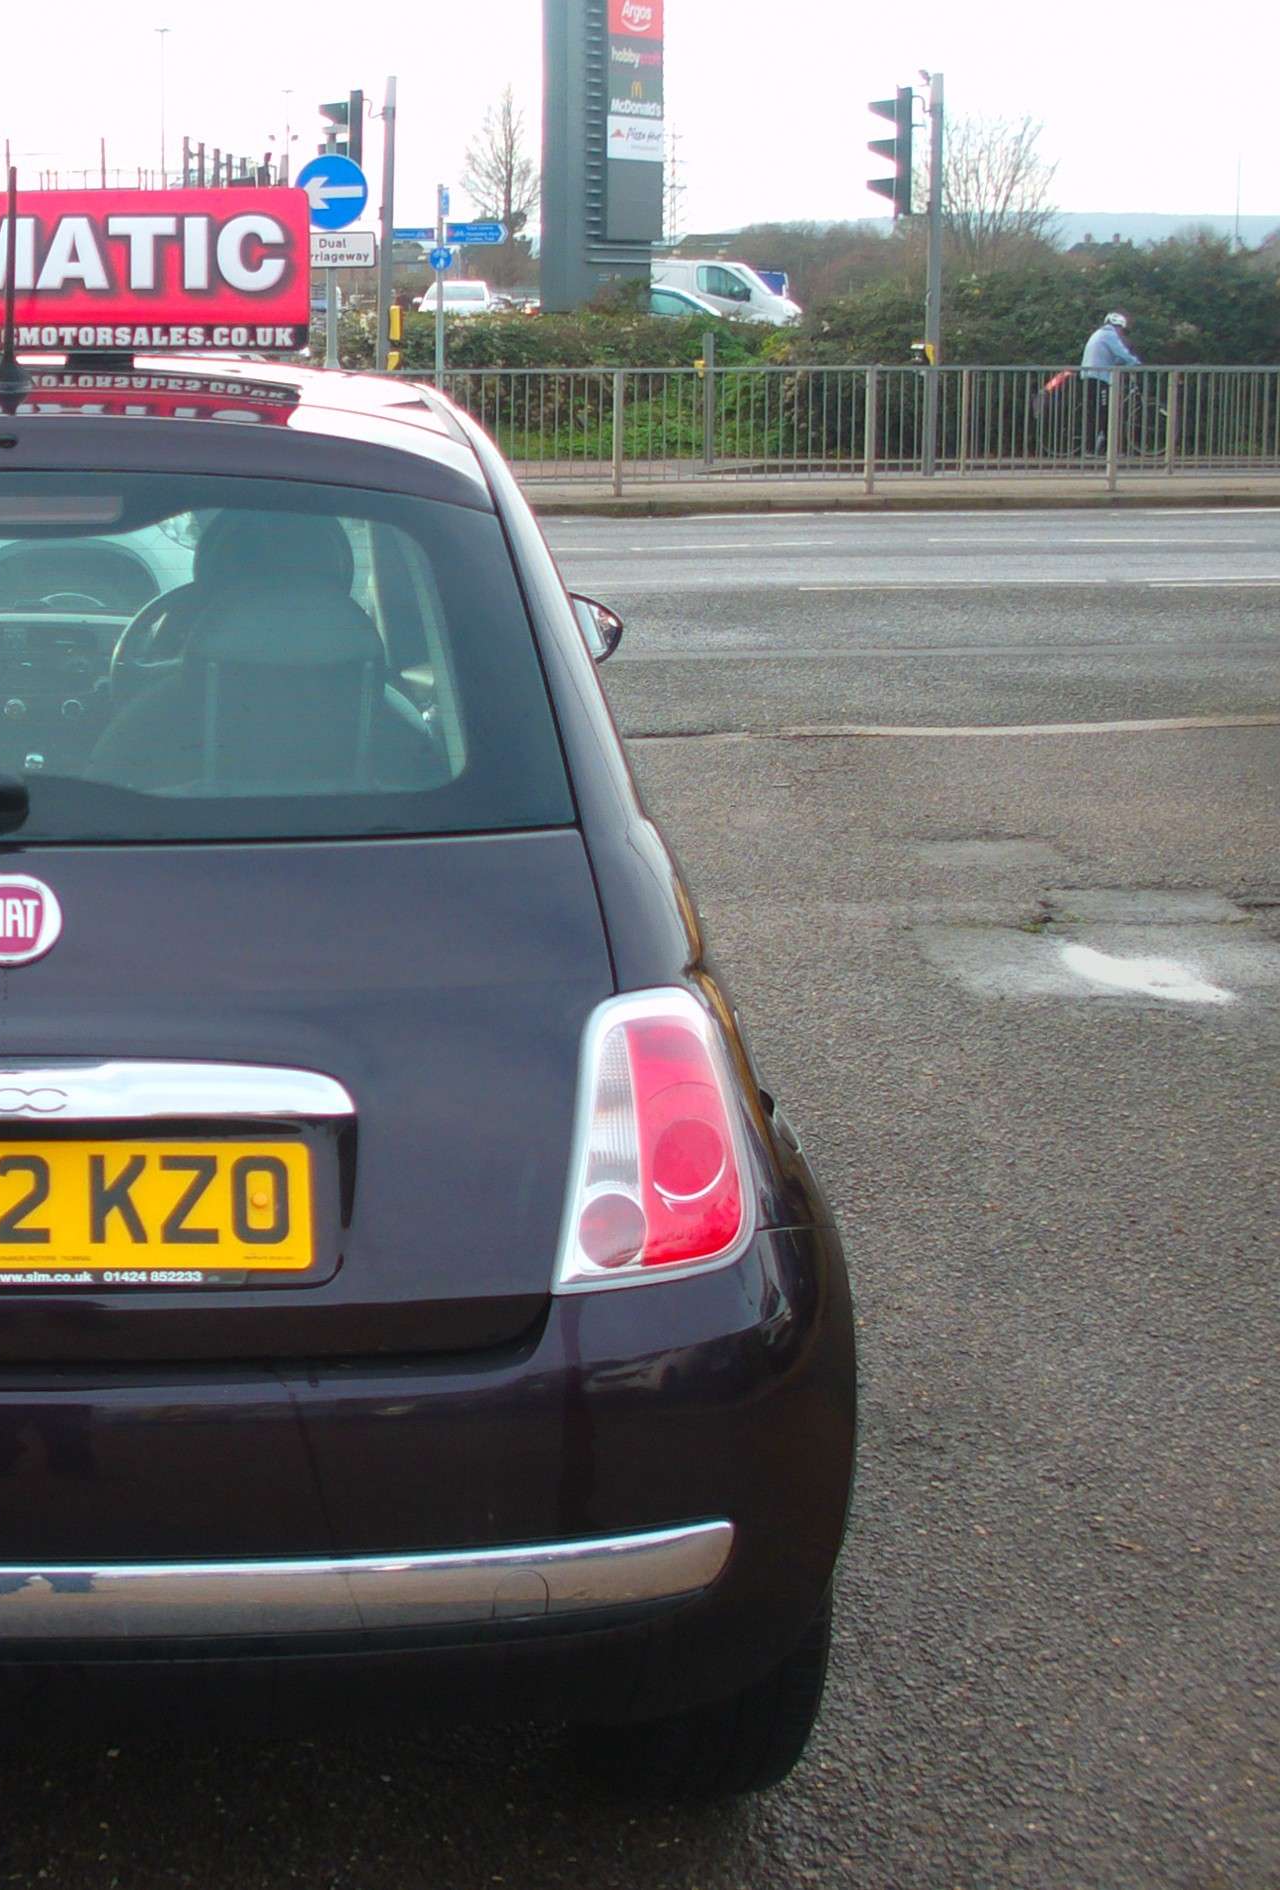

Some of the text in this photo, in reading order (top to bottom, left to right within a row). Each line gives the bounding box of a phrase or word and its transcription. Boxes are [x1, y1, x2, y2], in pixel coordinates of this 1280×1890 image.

[621, 0, 653, 24] Argos
[611, 98, 661, 117] McDonald's
[319, 238, 347, 249] Dual
[311, 251, 369, 264] riageway
[103, 1271, 147, 1282] 01424
[150, 1271, 203, 1282] 852233
